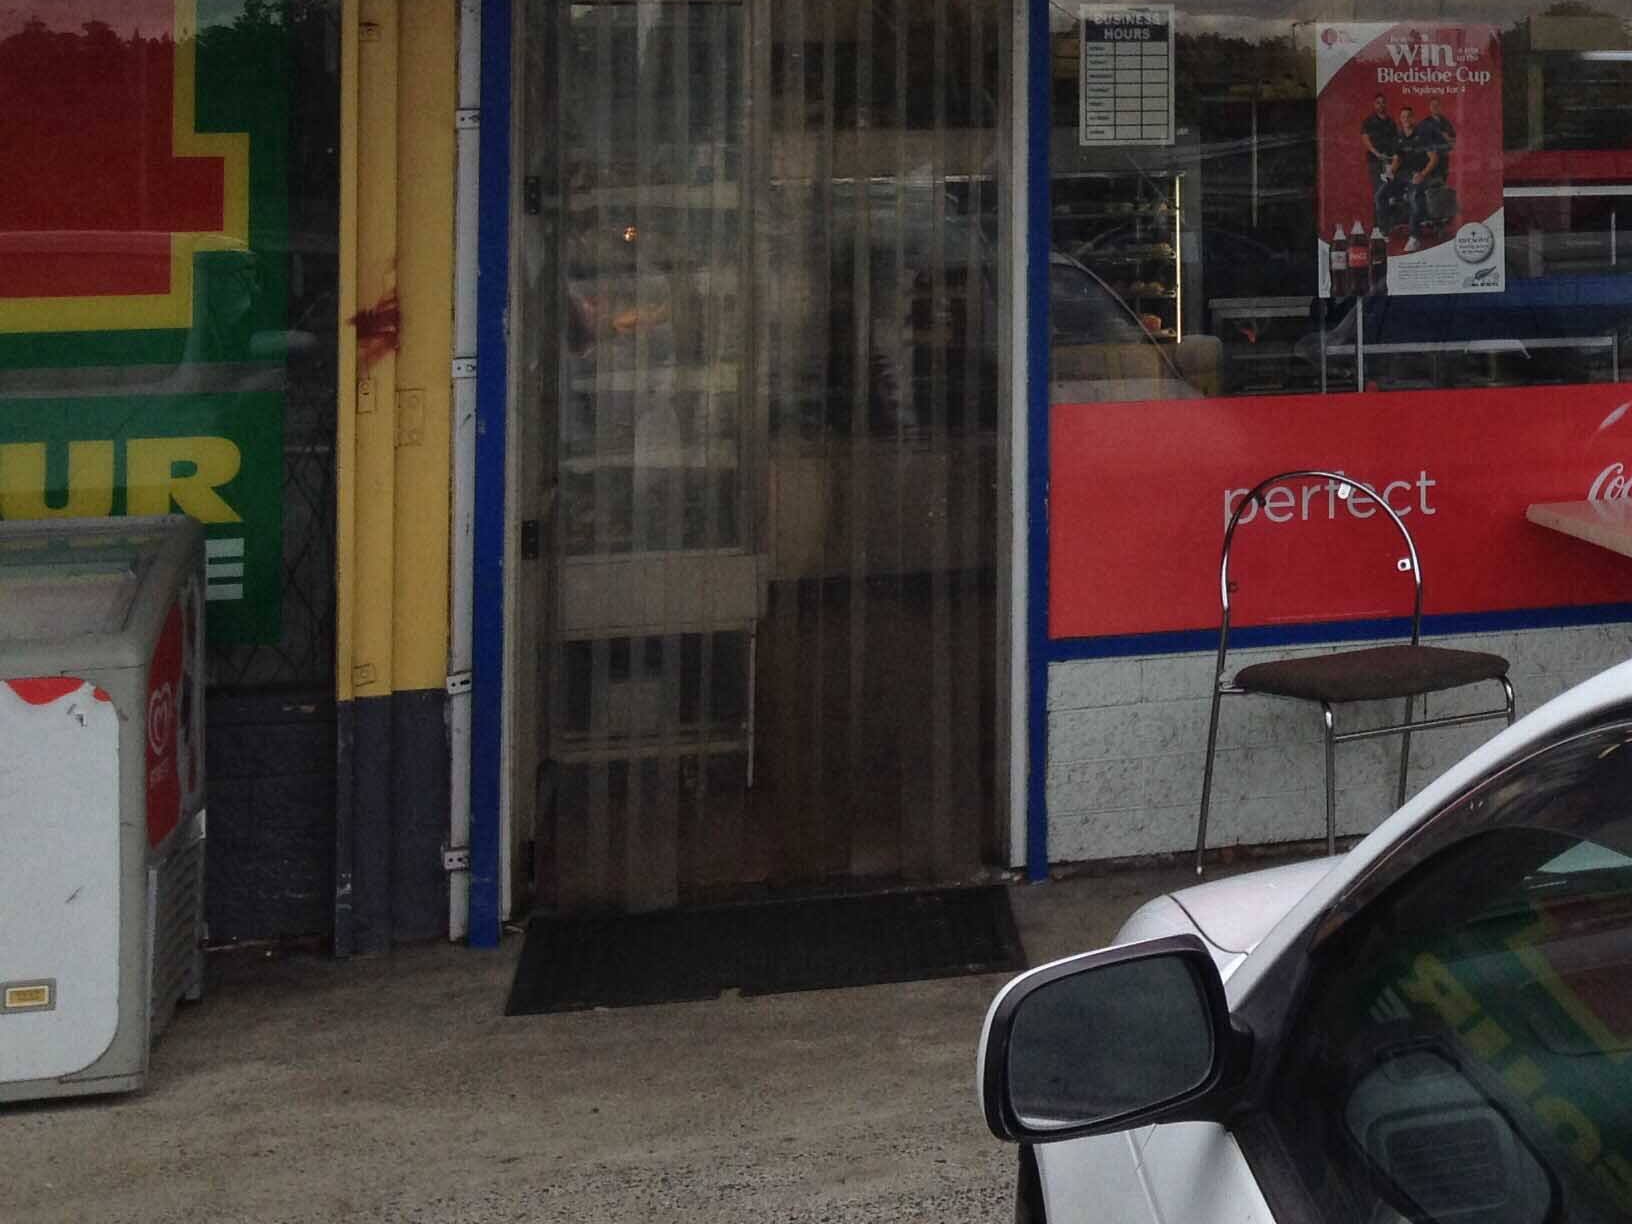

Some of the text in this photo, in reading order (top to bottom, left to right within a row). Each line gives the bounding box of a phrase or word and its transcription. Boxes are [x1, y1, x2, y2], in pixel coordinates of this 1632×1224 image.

[1103, 27, 1151, 41] HOURS
[1386, 33, 1457, 68] win
[1376, 66, 1491, 87] Bledisloe Cup
[1223, 469, 1437, 526] perfect
